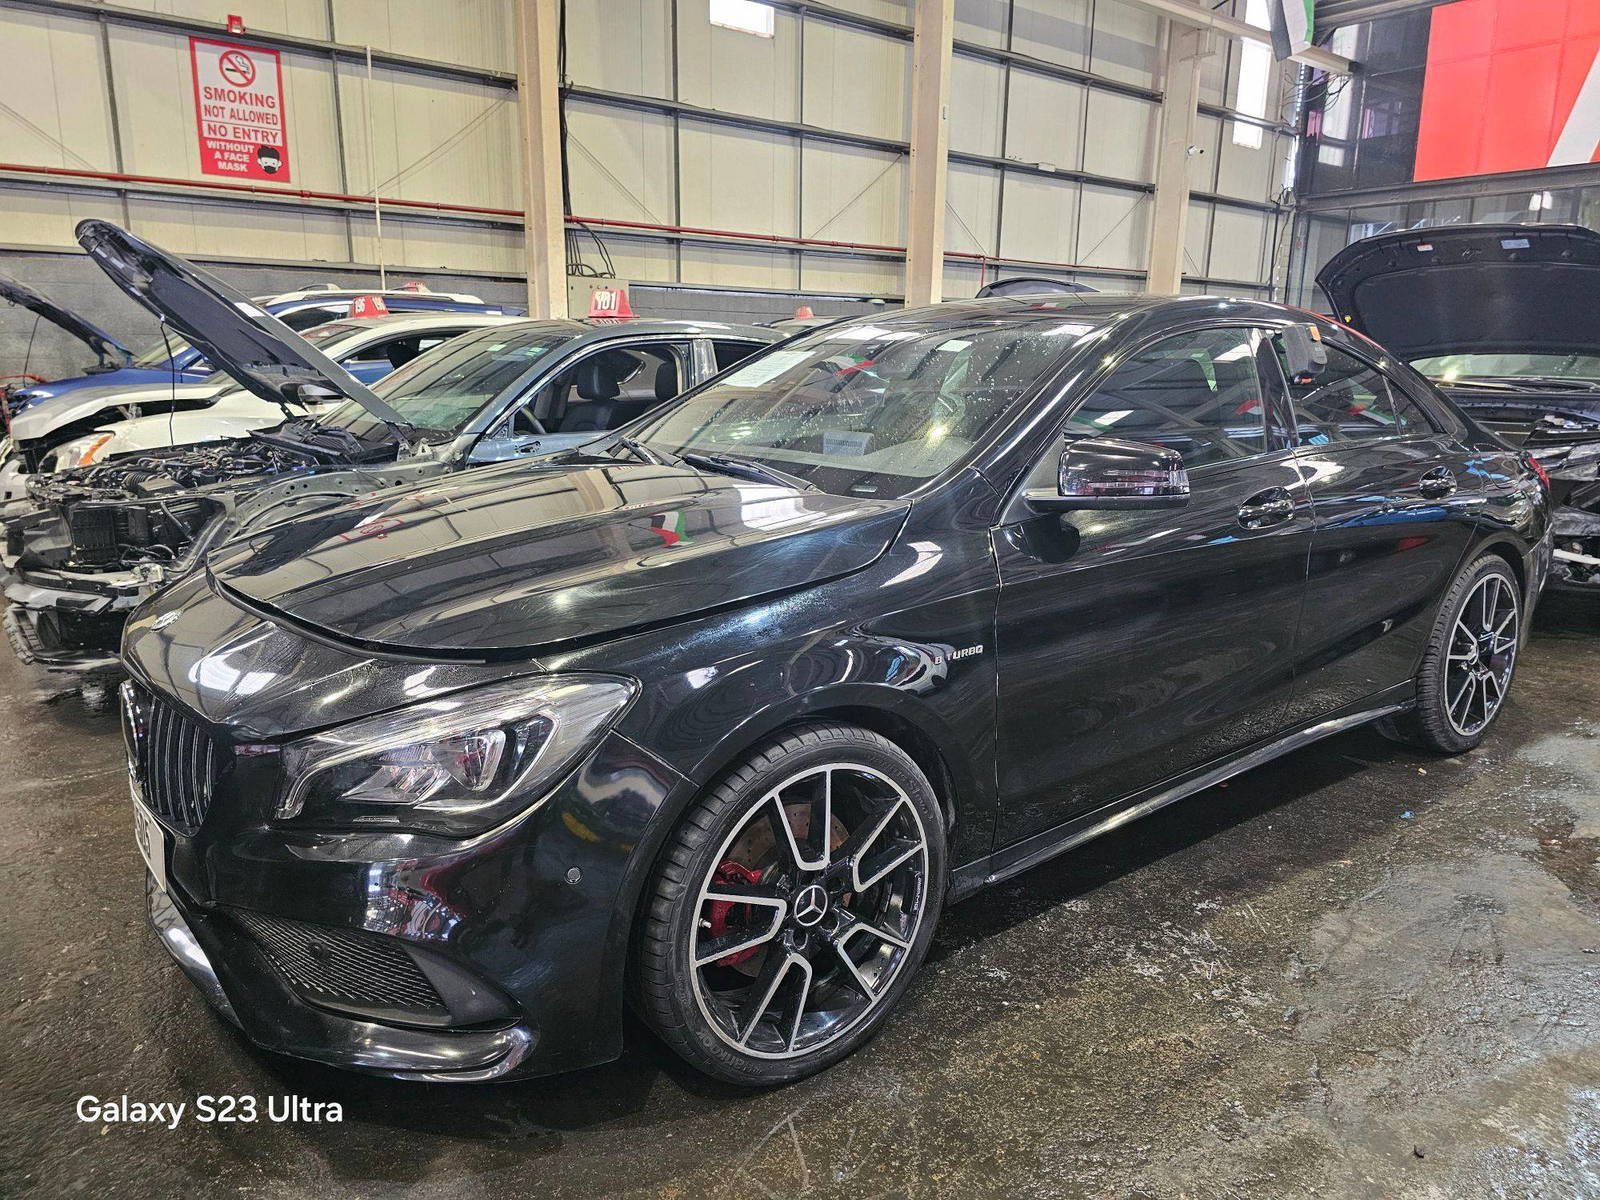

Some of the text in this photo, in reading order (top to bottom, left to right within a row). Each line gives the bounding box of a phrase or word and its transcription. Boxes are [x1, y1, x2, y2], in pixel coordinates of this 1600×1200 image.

[204, 86, 276, 108] SMOKING
[204, 104, 278, 125] NOT ALLOWED
[207, 123, 278, 143] NO ENTRY
[206, 140, 255, 153] WITHOUT
[214, 151, 250, 163] A FACE
[217, 161, 248, 172] MASK
